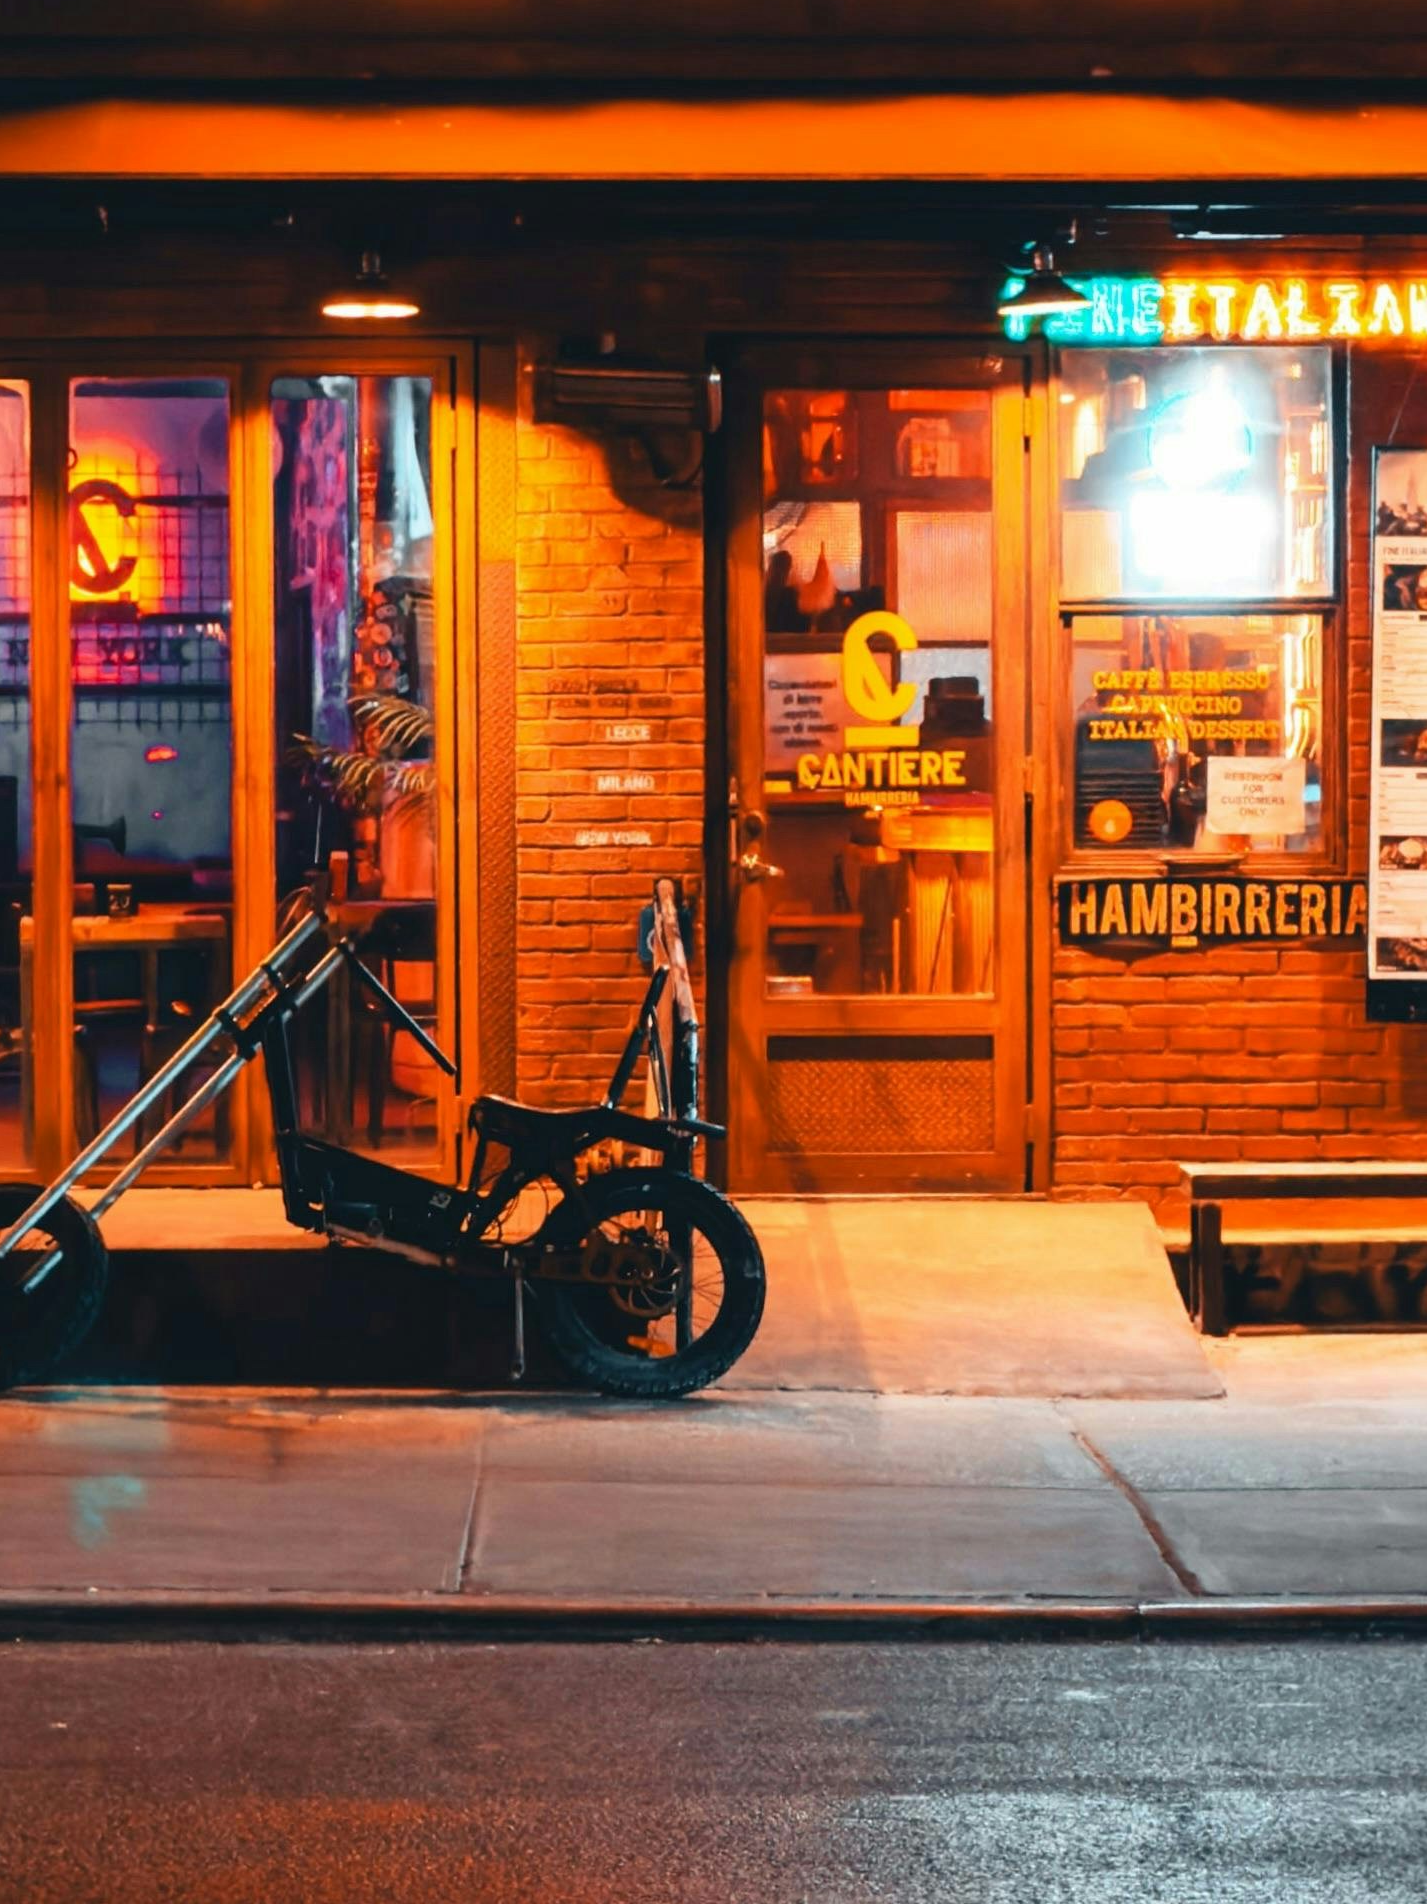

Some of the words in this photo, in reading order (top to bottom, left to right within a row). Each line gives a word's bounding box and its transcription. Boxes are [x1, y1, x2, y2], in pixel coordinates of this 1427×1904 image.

[1170, 670, 1271, 690] ESPRESSO
[1111, 695, 1242, 715] CAPPUCCINO
[605, 724, 651, 741] LECCE
[1089, 720, 1185, 739] ITALIAN
[1188, 720, 1280, 740] DESSERT
[797, 751, 966, 787] CANTIERE
[597, 775, 655, 791] MILANO
[575, 829, 609, 846] NEW
[612, 830, 652, 845] YORK
[1071, 883, 1367, 936] HAMBIRRERIA
